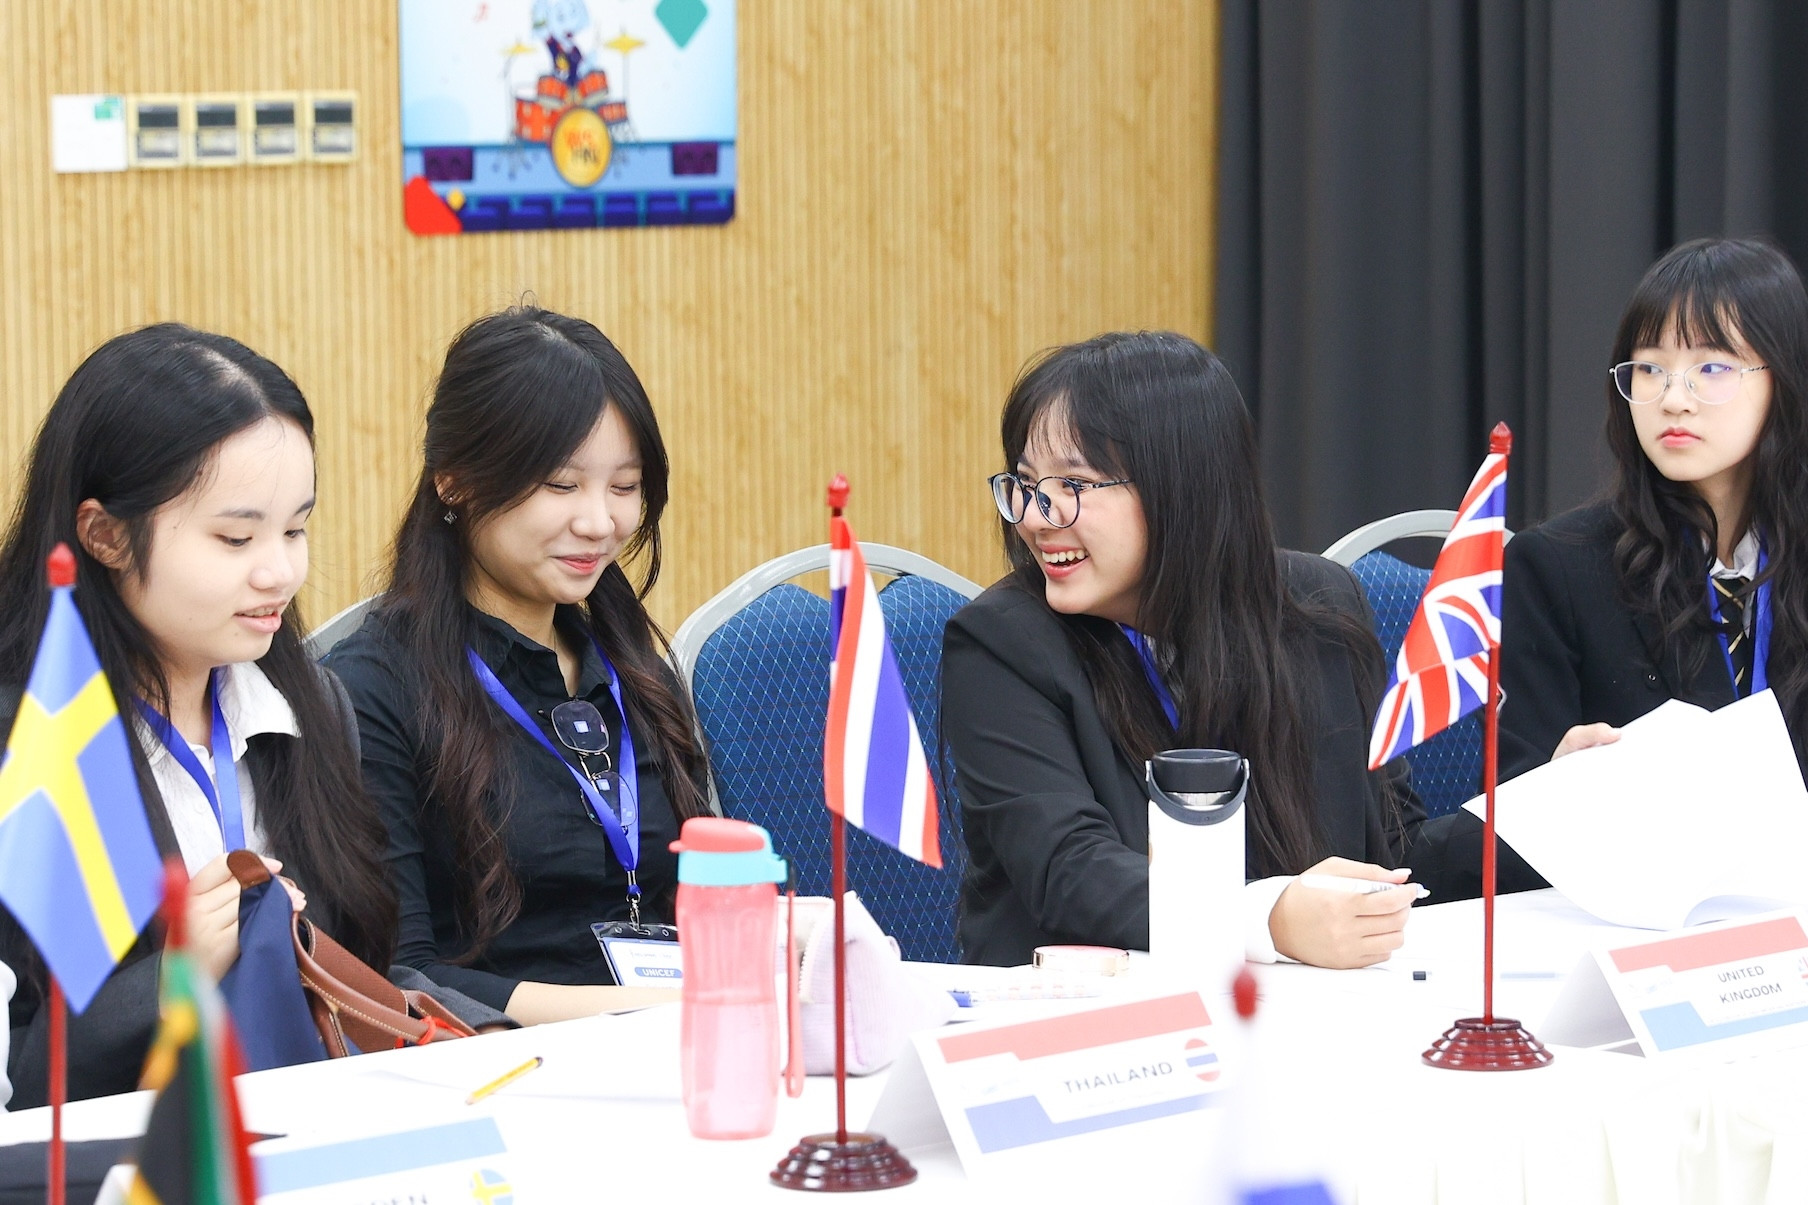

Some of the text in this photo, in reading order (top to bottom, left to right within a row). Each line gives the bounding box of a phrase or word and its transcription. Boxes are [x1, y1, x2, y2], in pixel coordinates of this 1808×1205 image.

[641, 968, 676, 977] UNICEF
[1717, 965, 1765, 983] UNITED
[1719, 982, 1783, 1004] KINGDOM
[1063, 1061, 1174, 1094] THAILAND
